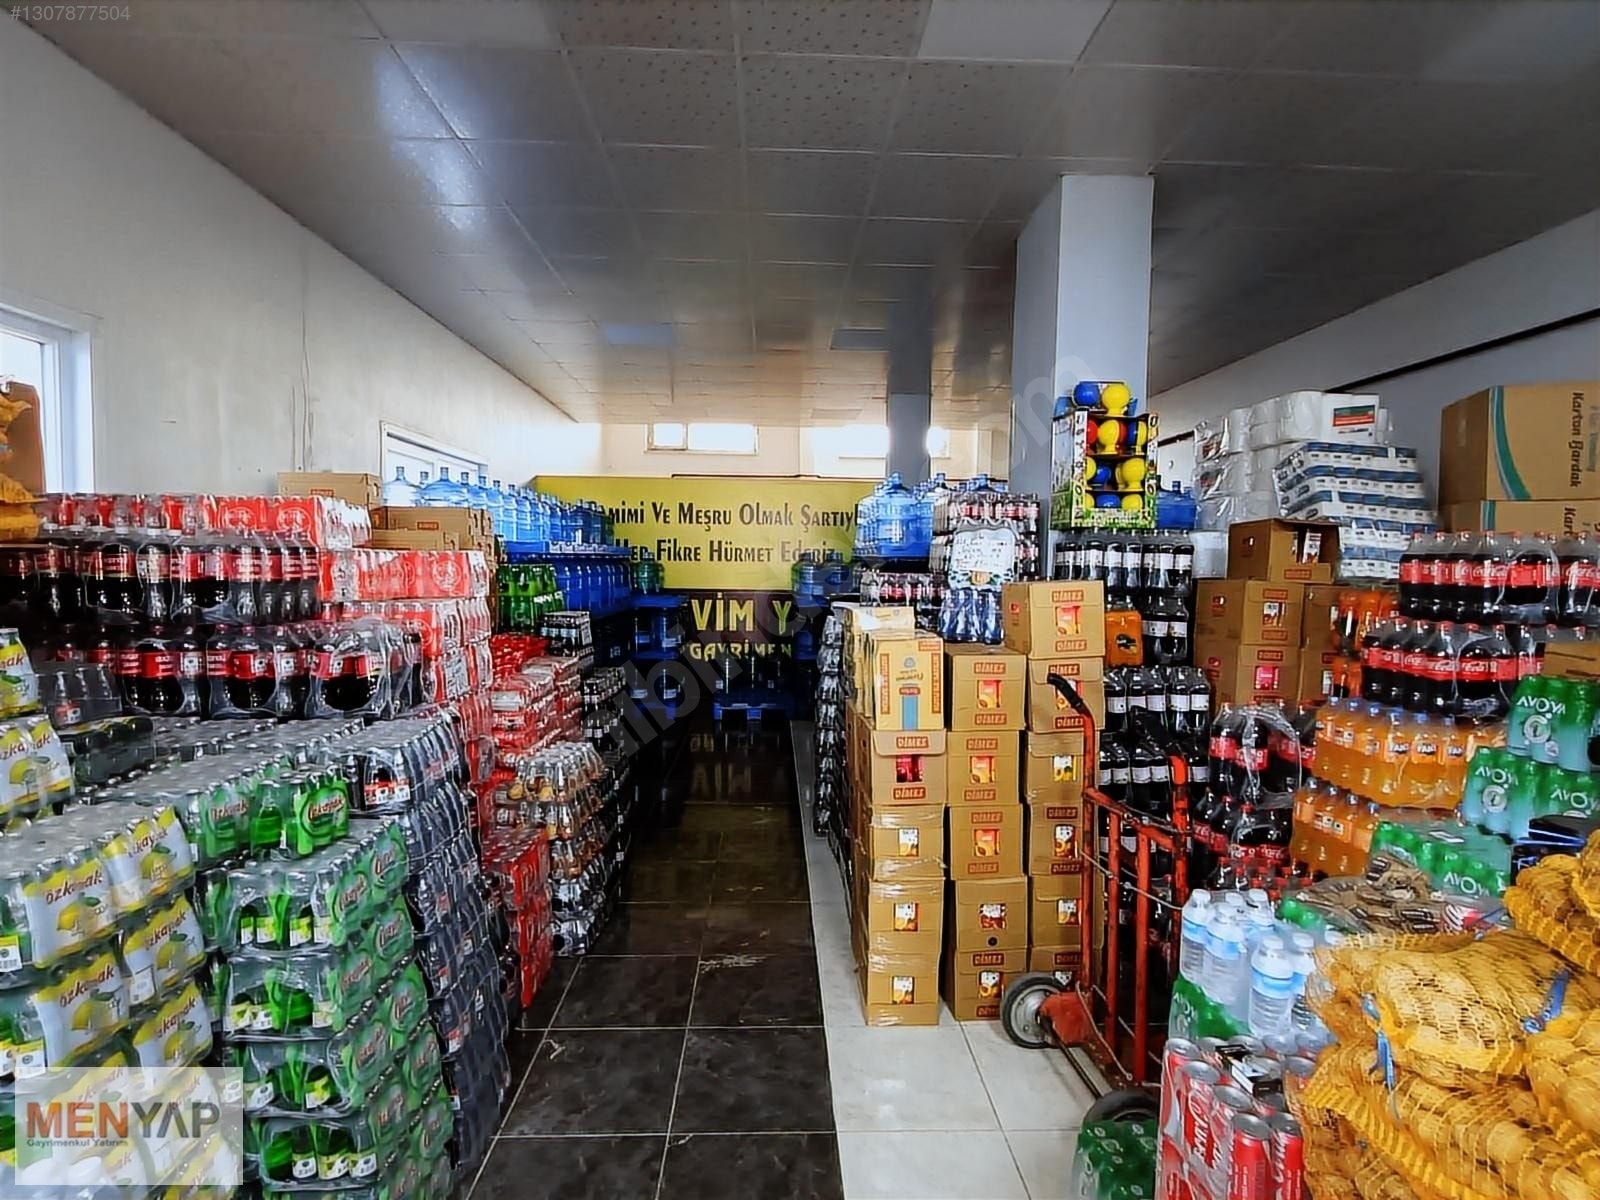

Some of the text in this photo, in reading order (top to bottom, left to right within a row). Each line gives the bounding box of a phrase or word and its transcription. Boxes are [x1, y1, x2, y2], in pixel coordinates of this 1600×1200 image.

[1568, 391, 1585, 488] Karton Bardak
[1564, 507, 1577, 537] Kart
[690, 591, 755, 632] VİM
[1516, 695, 1566, 715] AVOYA
[1550, 788, 1599, 810] AVOY
